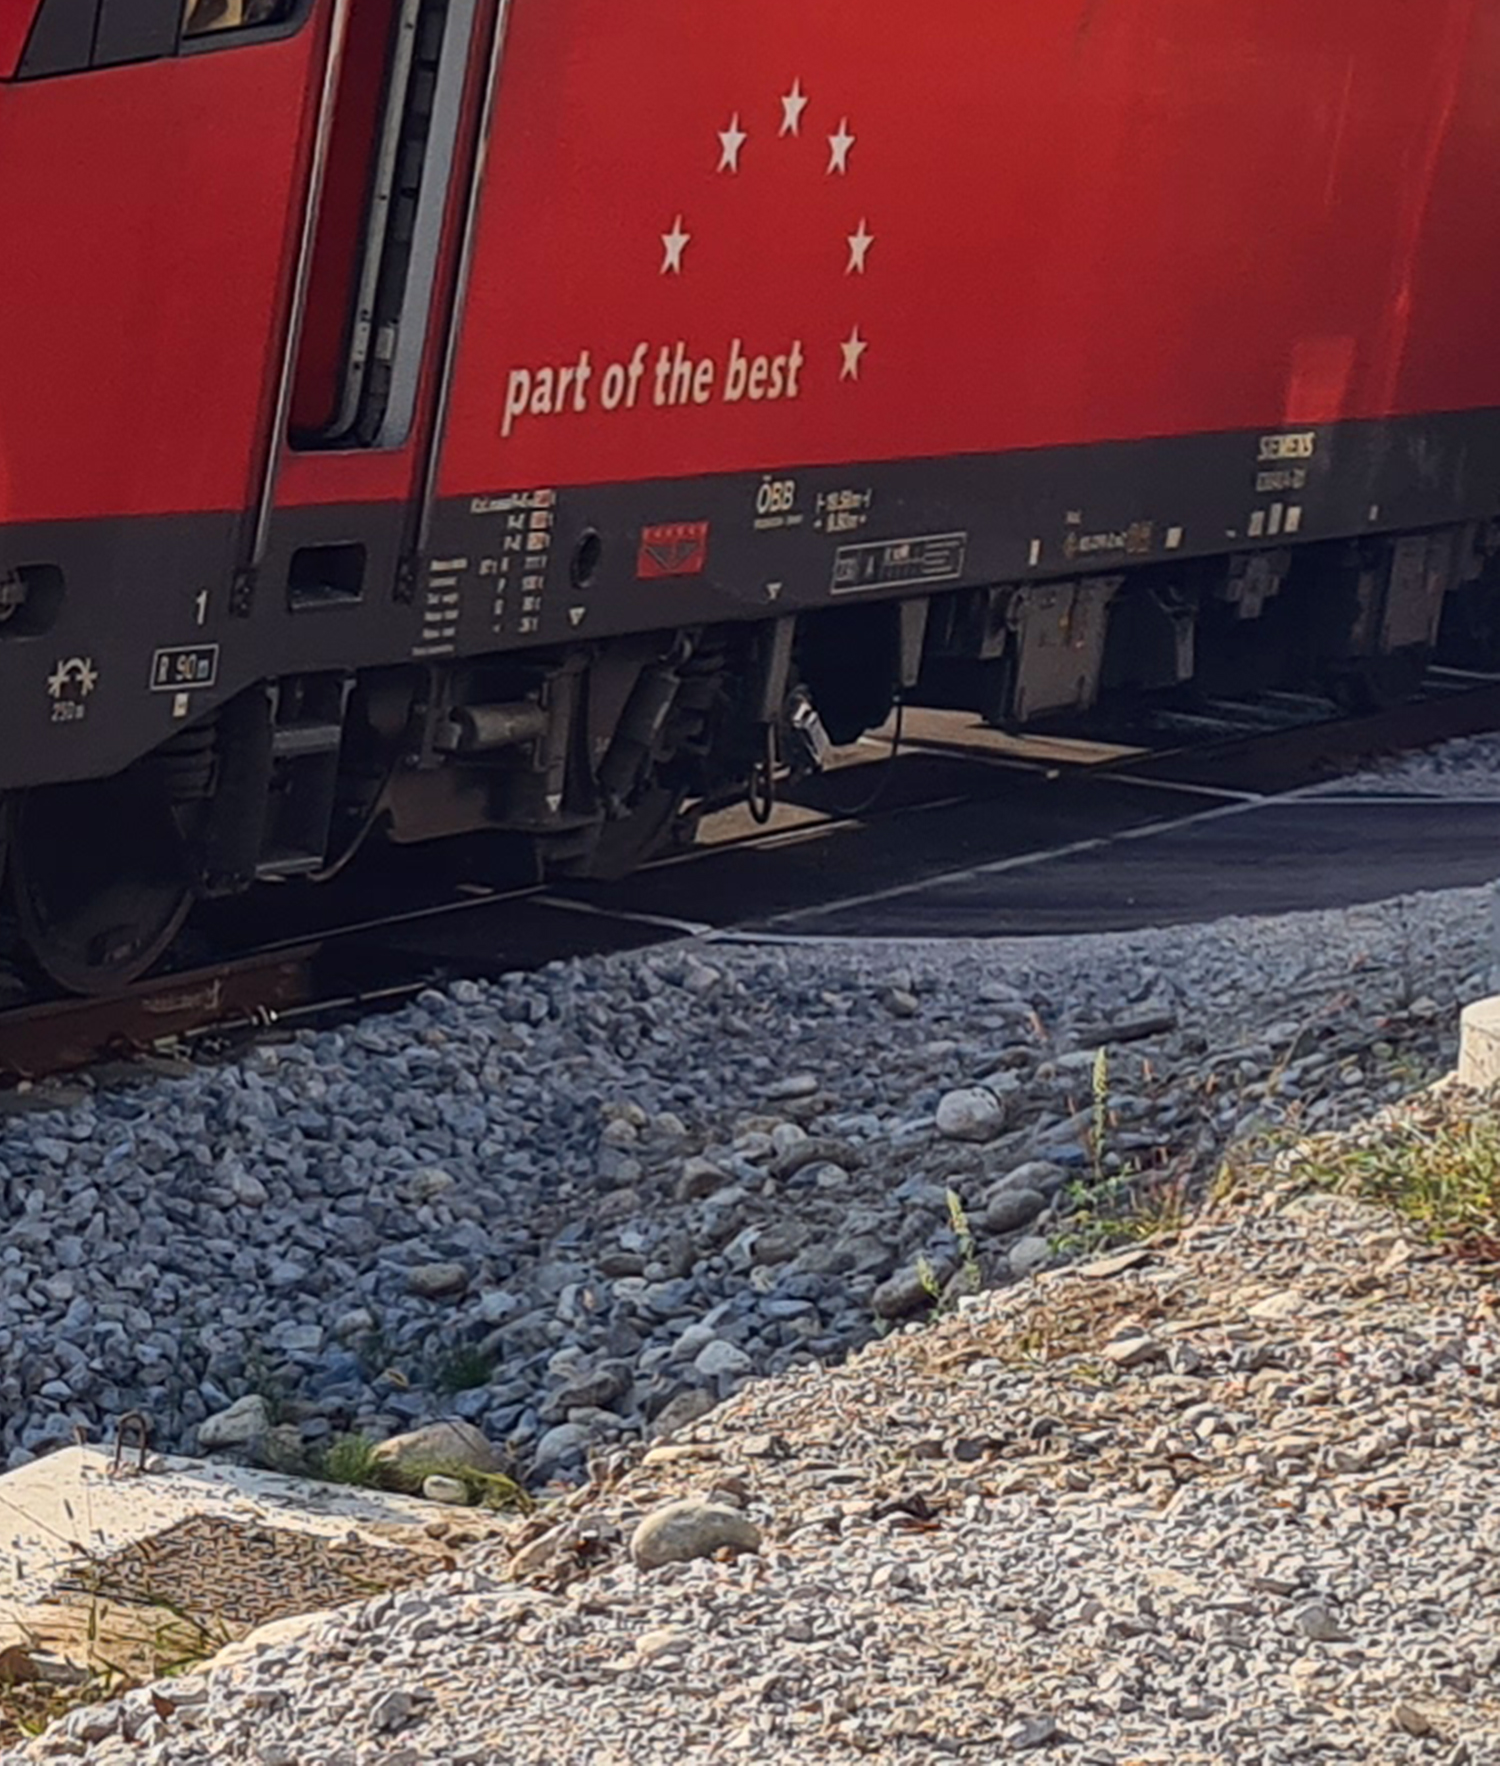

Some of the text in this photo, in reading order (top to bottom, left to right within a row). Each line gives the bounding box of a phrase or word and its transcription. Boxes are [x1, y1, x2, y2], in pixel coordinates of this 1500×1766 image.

[500, 337, 803, 437] part of the best
[756, 475, 795, 513] ÖBB
[196, 589, 208, 625] 1
